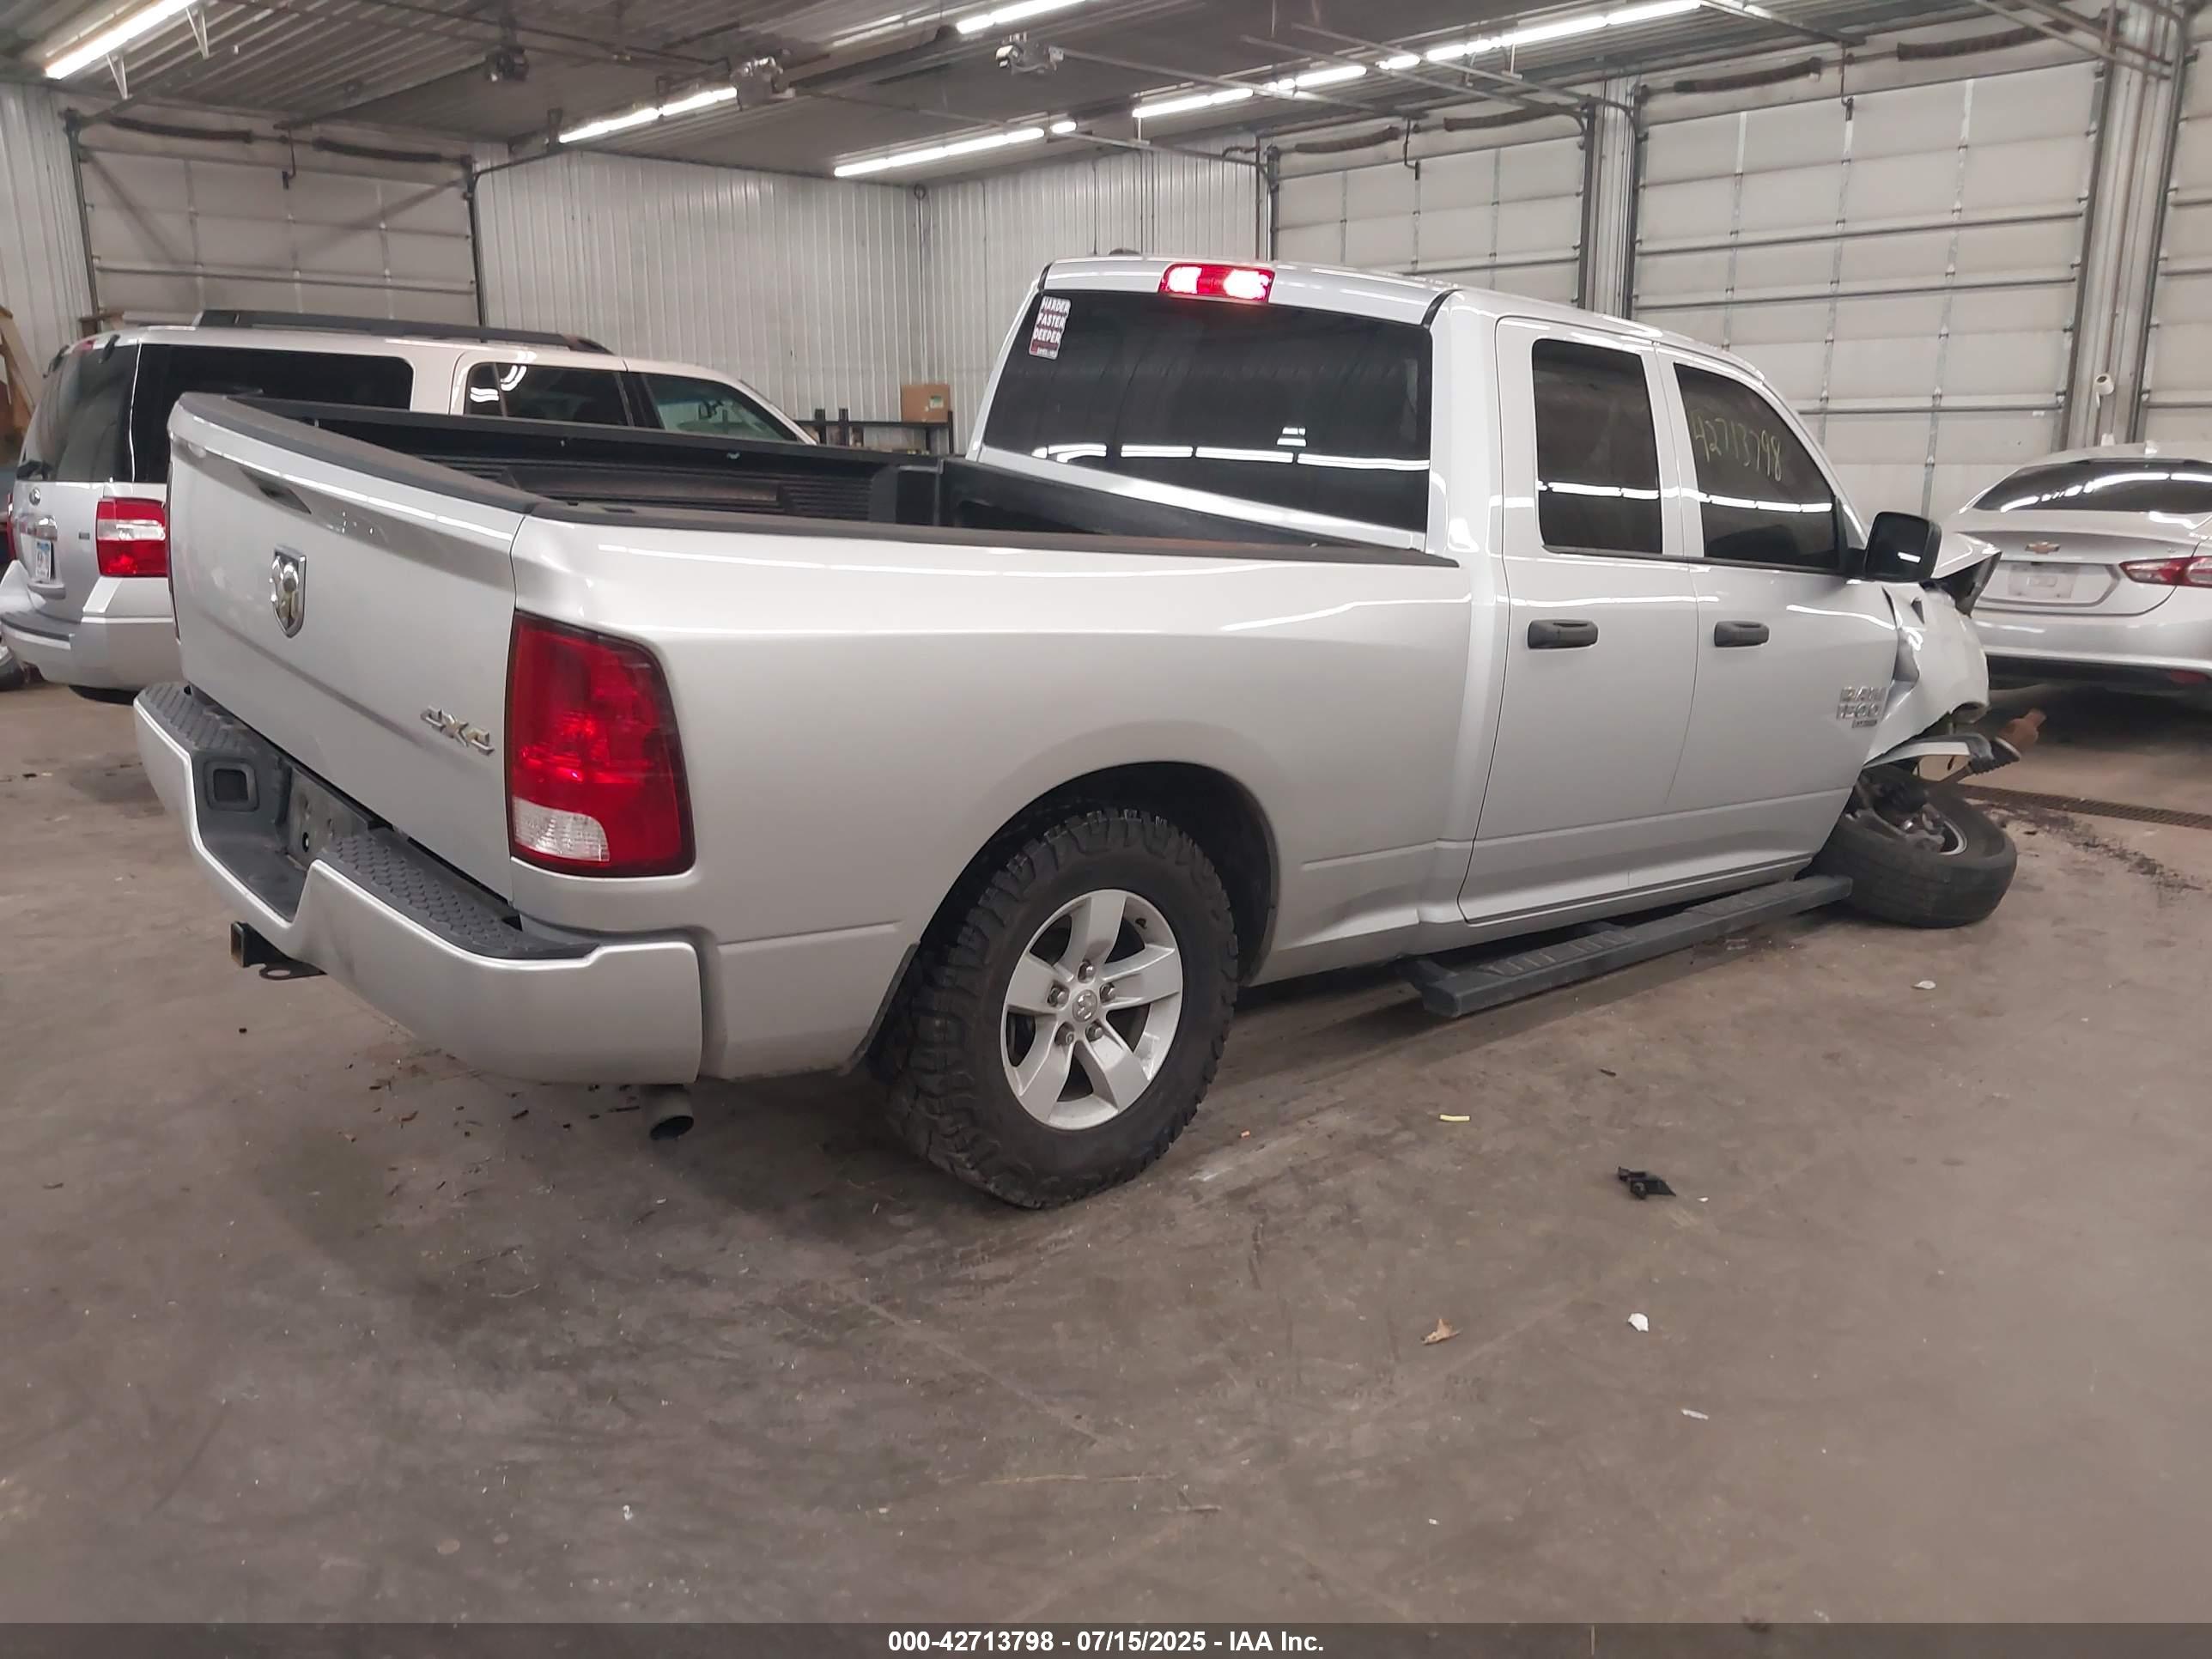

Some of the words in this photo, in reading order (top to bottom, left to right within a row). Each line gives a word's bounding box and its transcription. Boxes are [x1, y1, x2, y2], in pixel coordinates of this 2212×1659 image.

[1040, 295, 1072, 313] HARDER
[1036, 313, 1066, 329] FASTER
[1032, 327, 1061, 344] DEEPER
[1692, 414, 1783, 482] 42713798
